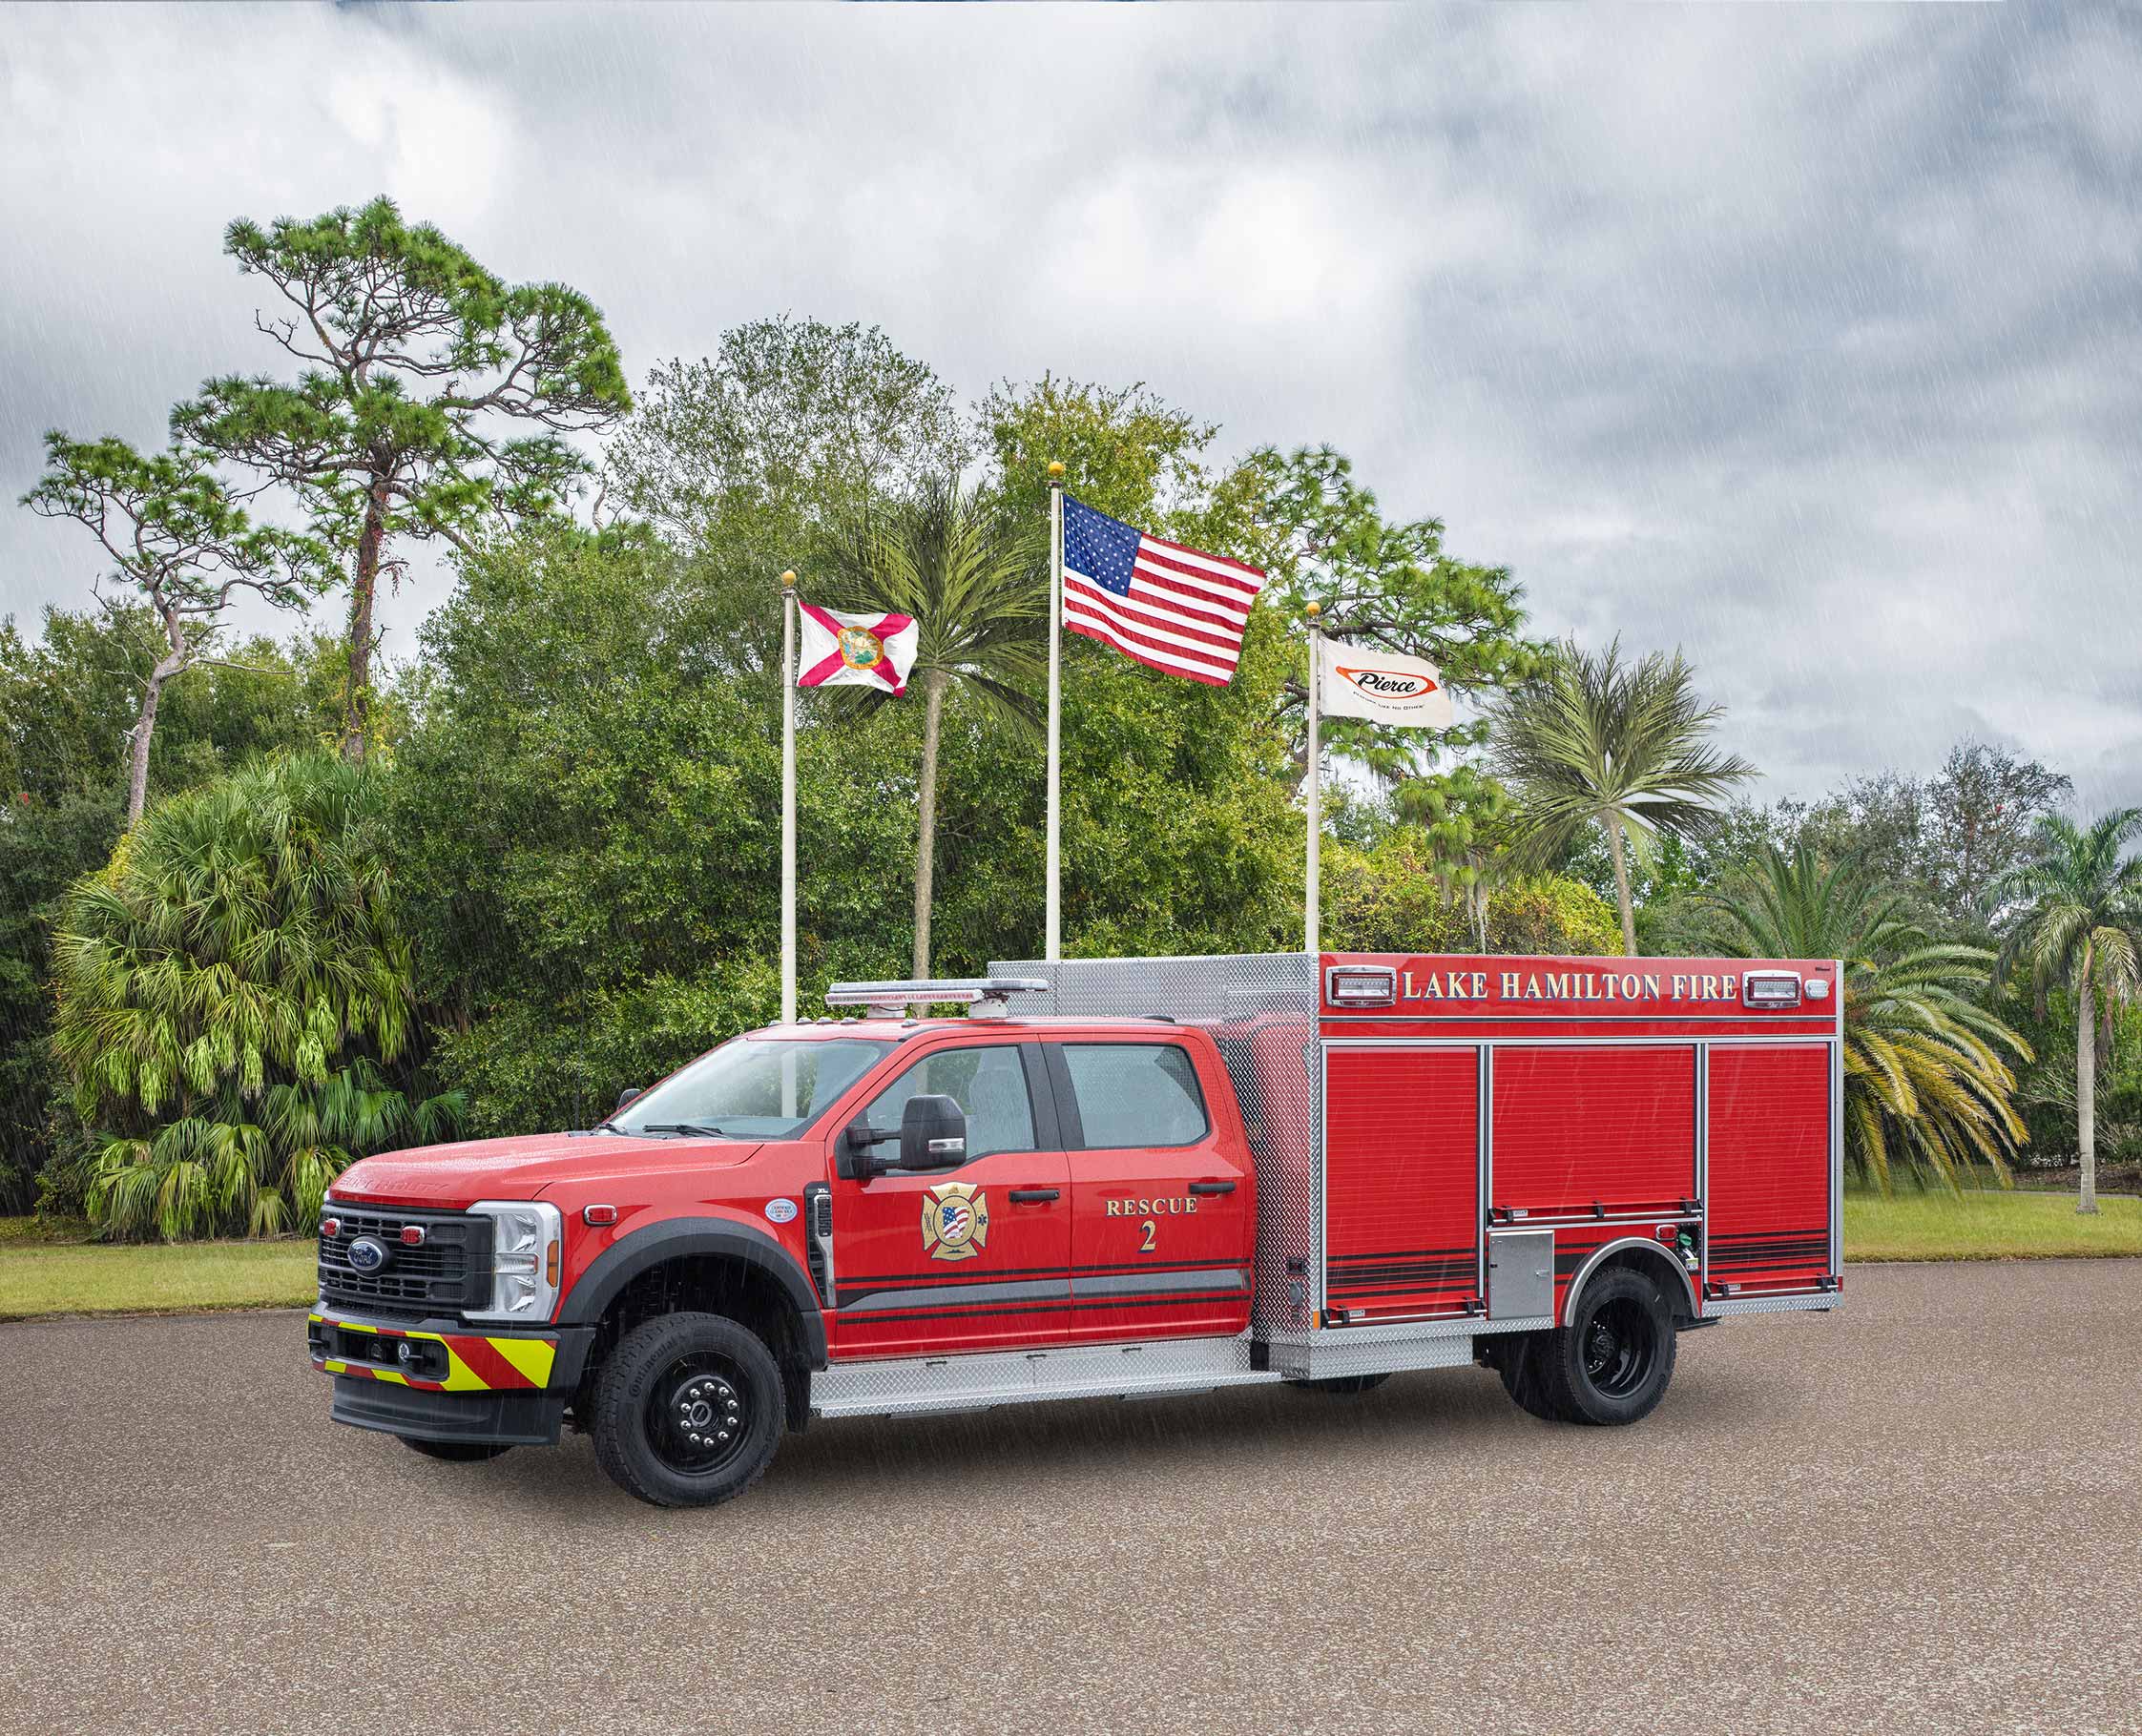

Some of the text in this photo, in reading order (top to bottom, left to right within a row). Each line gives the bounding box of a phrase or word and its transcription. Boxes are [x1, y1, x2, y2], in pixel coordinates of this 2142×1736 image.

[1358, 672, 1416, 692] Pierce
[1402, 971, 1737, 1002] LAKE HAMILTON FIRE
[1106, 1197, 1198, 1216] RESCUE
[1138, 1220, 1157, 1253] 2
